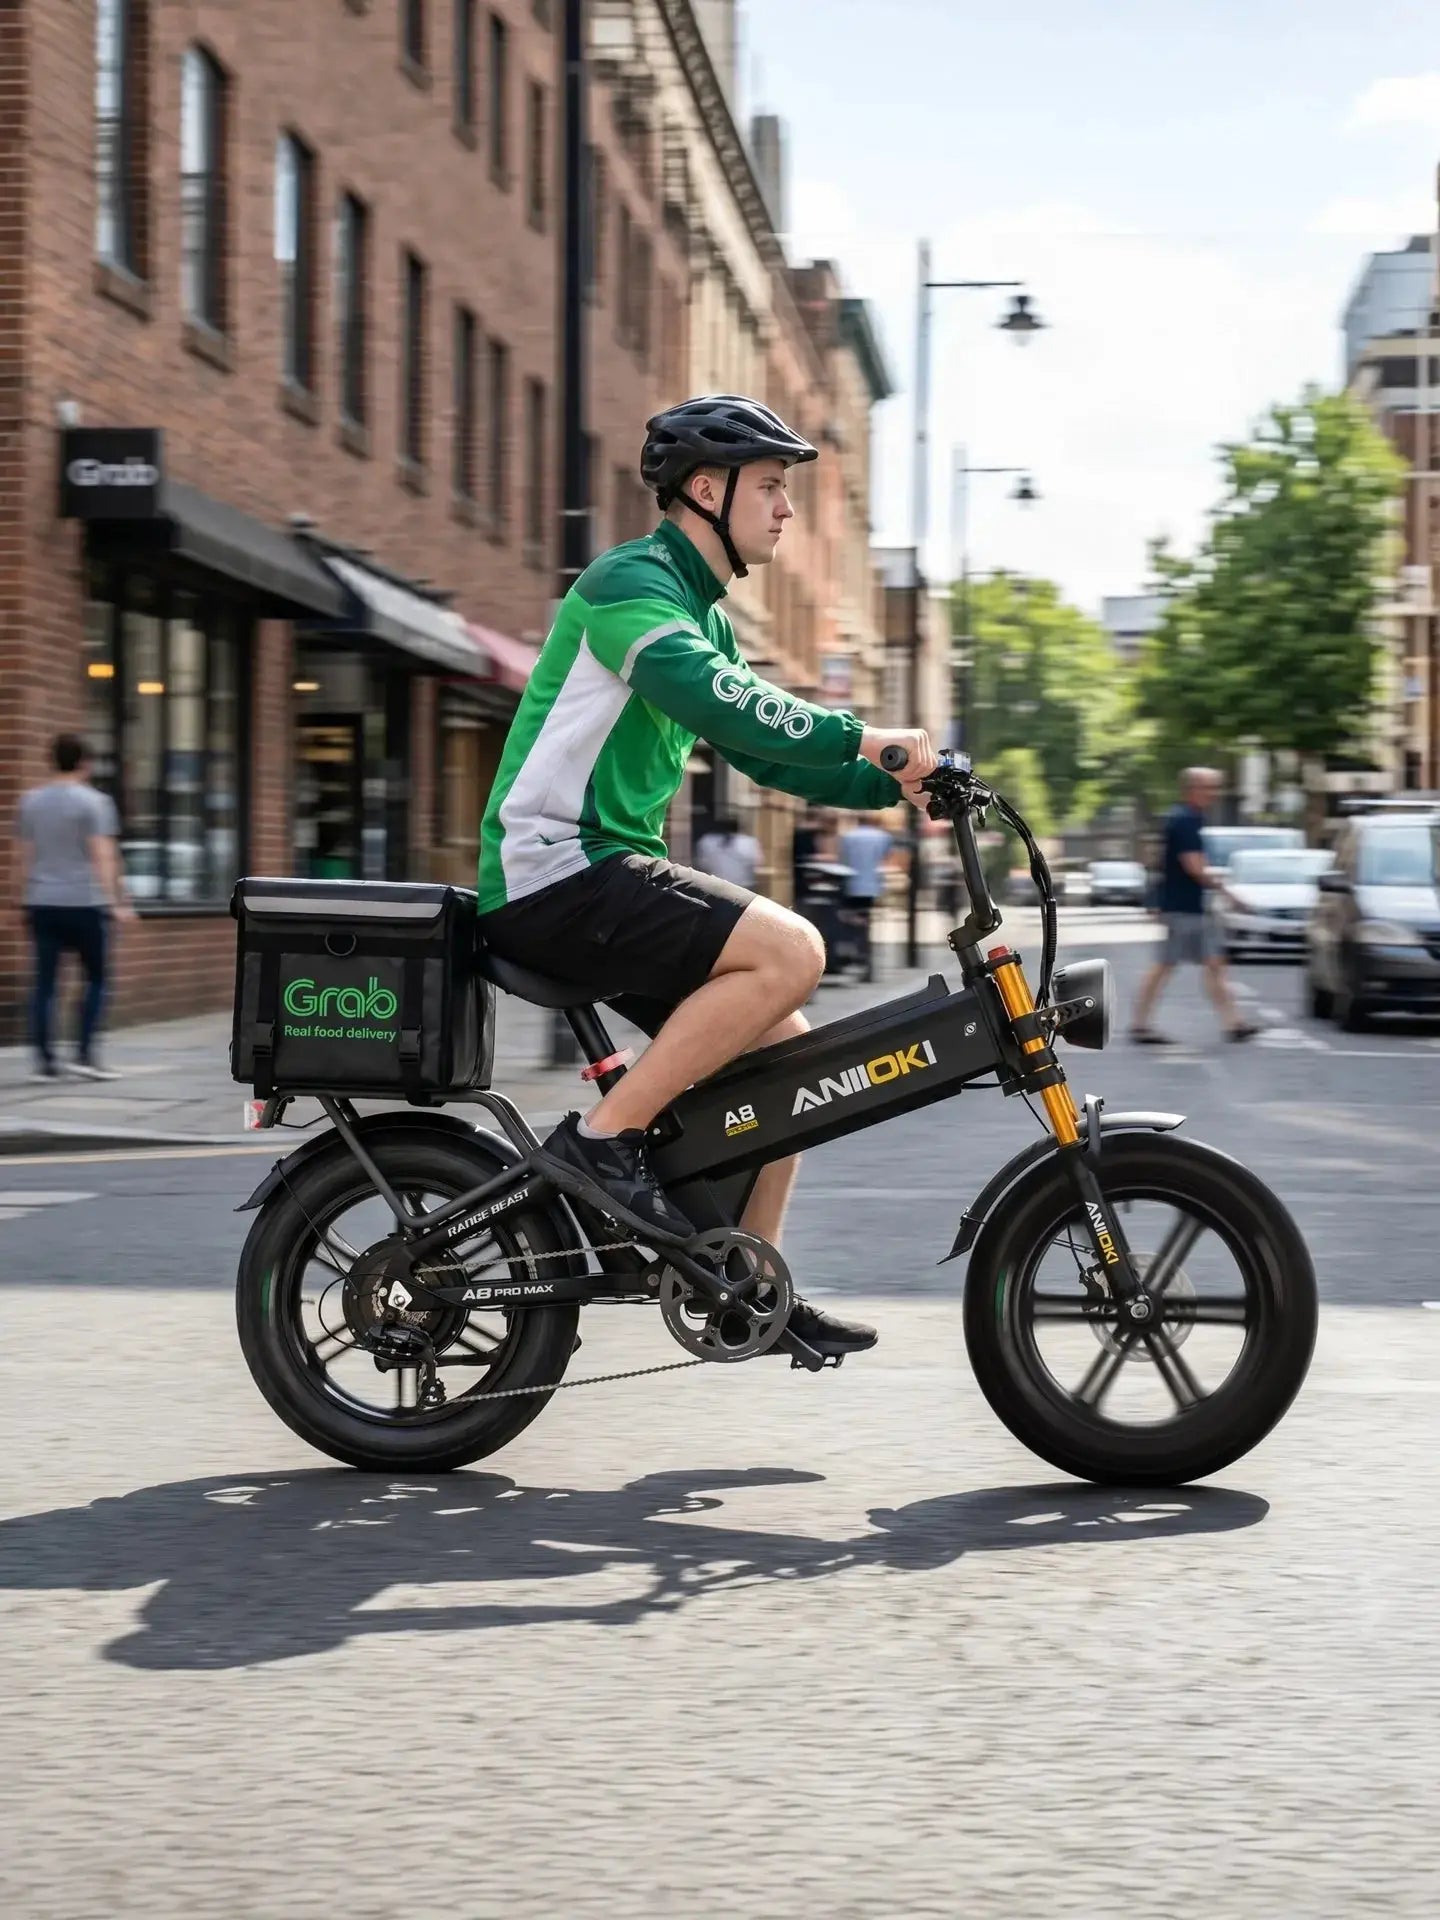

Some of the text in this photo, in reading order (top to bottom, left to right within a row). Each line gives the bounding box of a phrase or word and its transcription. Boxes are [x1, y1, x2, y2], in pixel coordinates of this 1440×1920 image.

[712, 668, 814, 739] Grab
[284, 977, 397, 1019] Grab
[284, 1025, 397, 1042] Real food delivery
[792, 1039, 938, 1116] ANIIOKI
[725, 1104, 756, 1129] A8
[447, 1187, 529, 1238] RANGE BEAST
[1085, 1201, 1119, 1265] ANIIOKI
[462, 1284, 554, 1301] A8 PRO MAX
